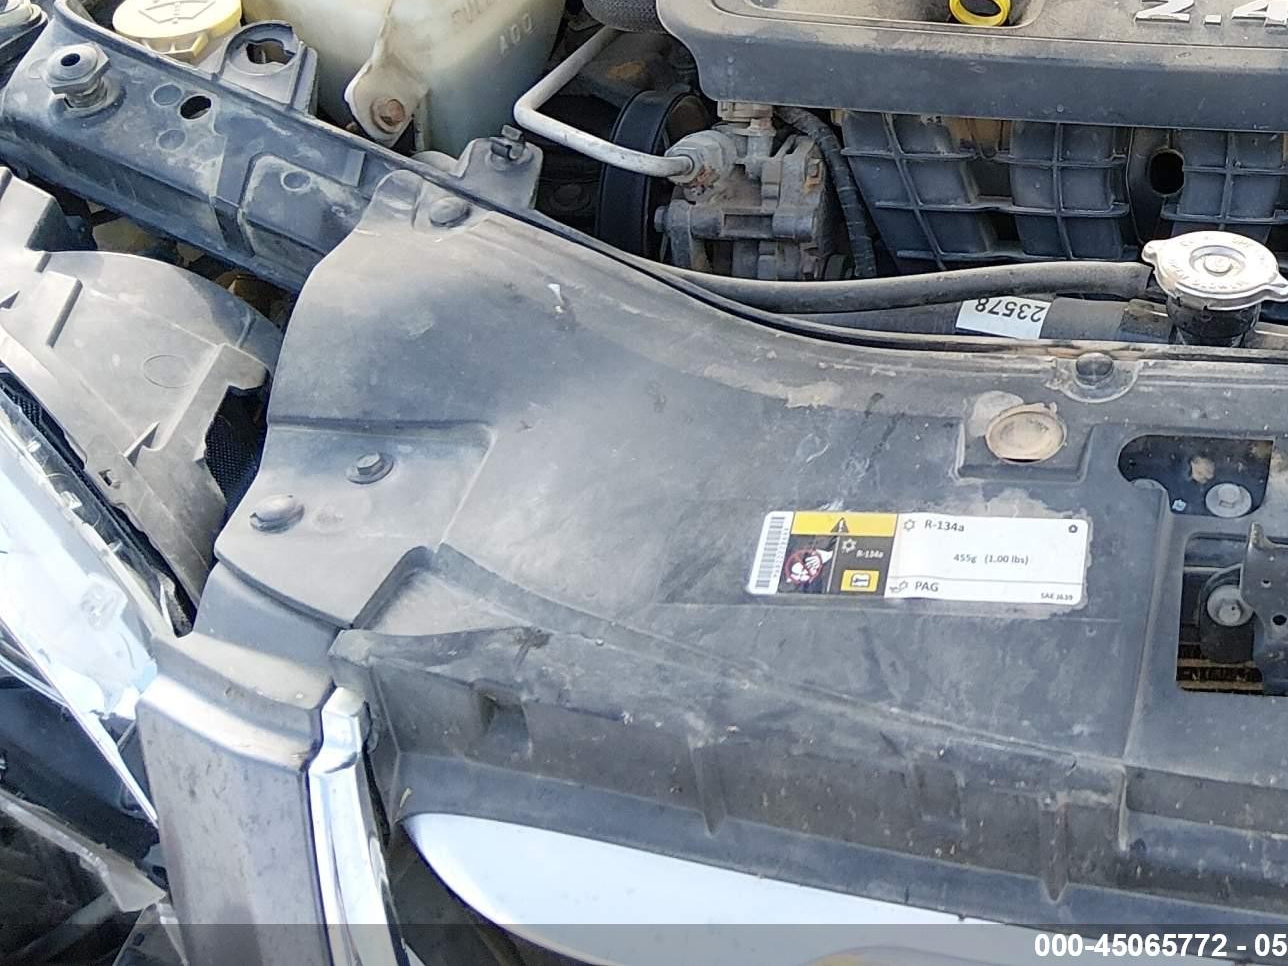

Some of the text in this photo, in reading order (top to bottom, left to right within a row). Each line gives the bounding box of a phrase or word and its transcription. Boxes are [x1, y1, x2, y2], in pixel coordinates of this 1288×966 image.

[975, 297, 1047, 323] 23578
[924, 519, 965, 533] R-134a
[953, 553, 1029, 566] 455g (1.00 lbs)
[914, 582, 939, 593] PAG
